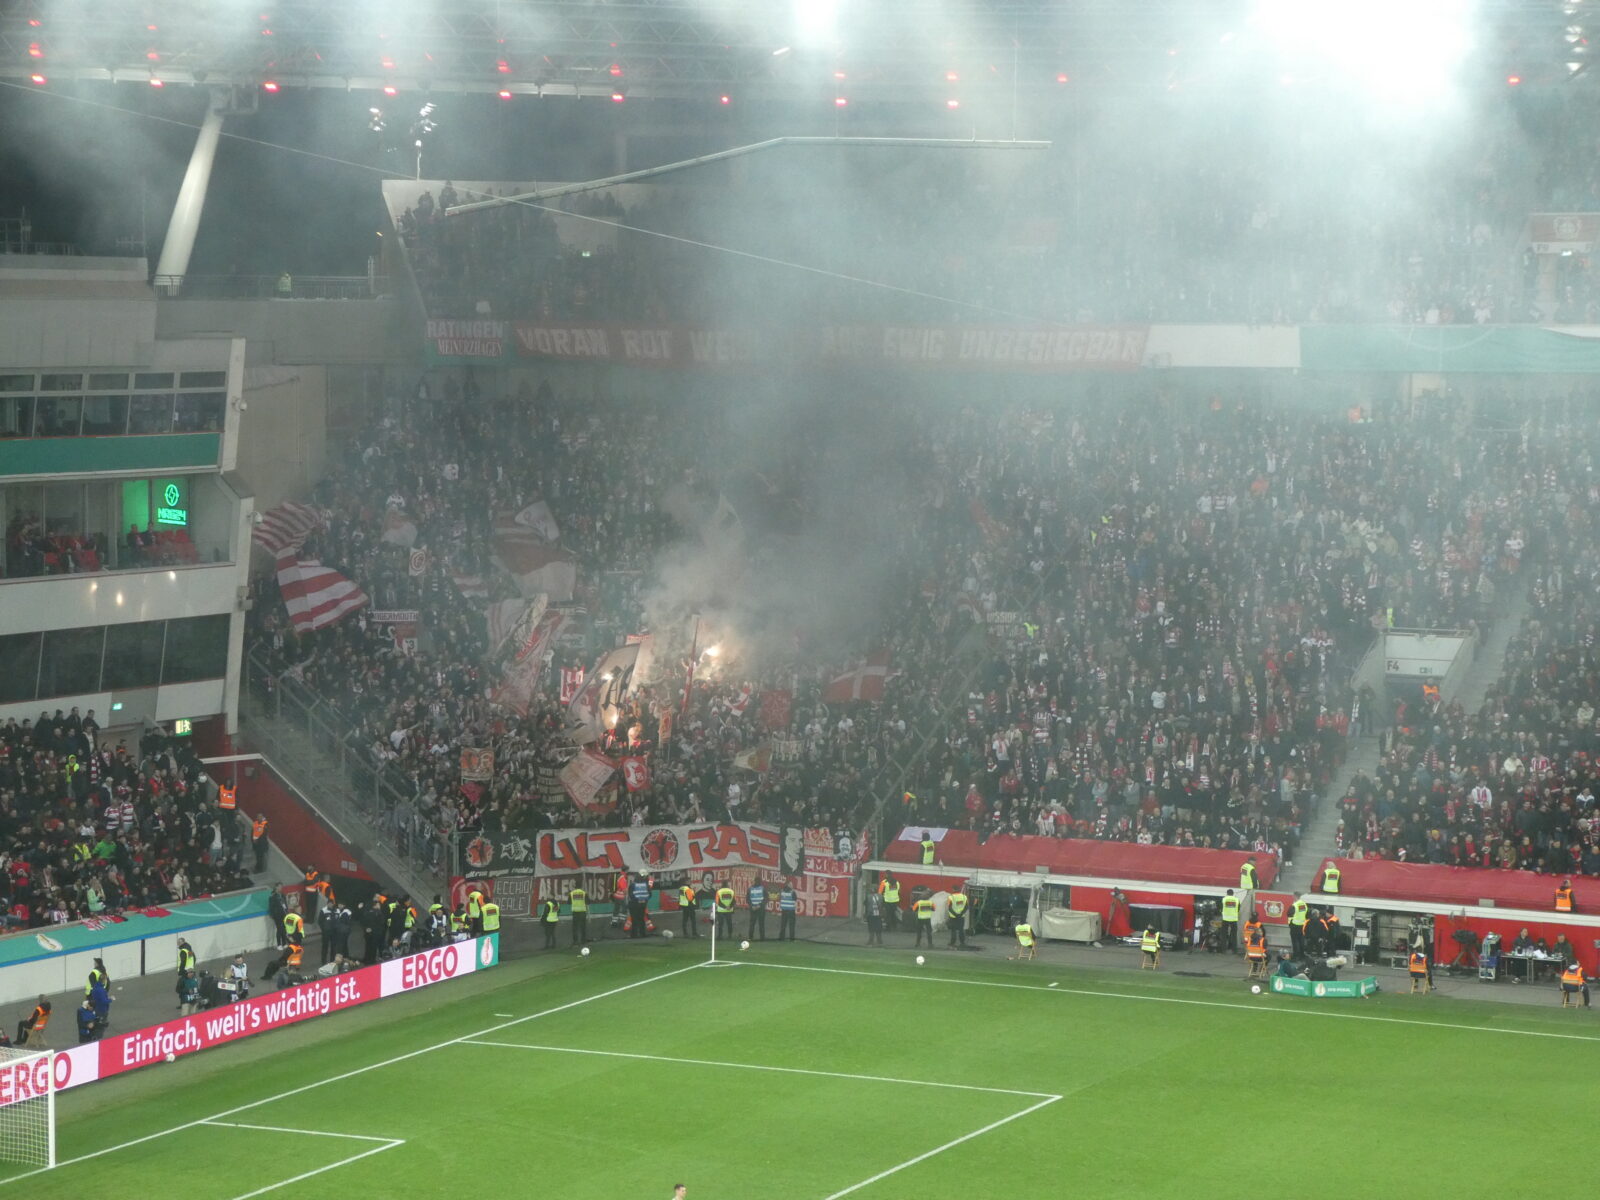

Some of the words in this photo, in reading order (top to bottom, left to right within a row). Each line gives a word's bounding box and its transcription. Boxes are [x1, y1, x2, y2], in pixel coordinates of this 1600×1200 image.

[516, 328, 609, 357] VORAN
[621, 329, 673, 359] ROT
[1386, 660, 1400, 672] F4
[402, 945, 458, 989] ERGO
[123, 1019, 202, 1066] Einfach,
[206, 1003, 262, 1041] weil's
[265, 982, 330, 1024] wichtig
[335, 976, 361, 1006] ist.
[0, 1052, 72, 1105] ERGO
